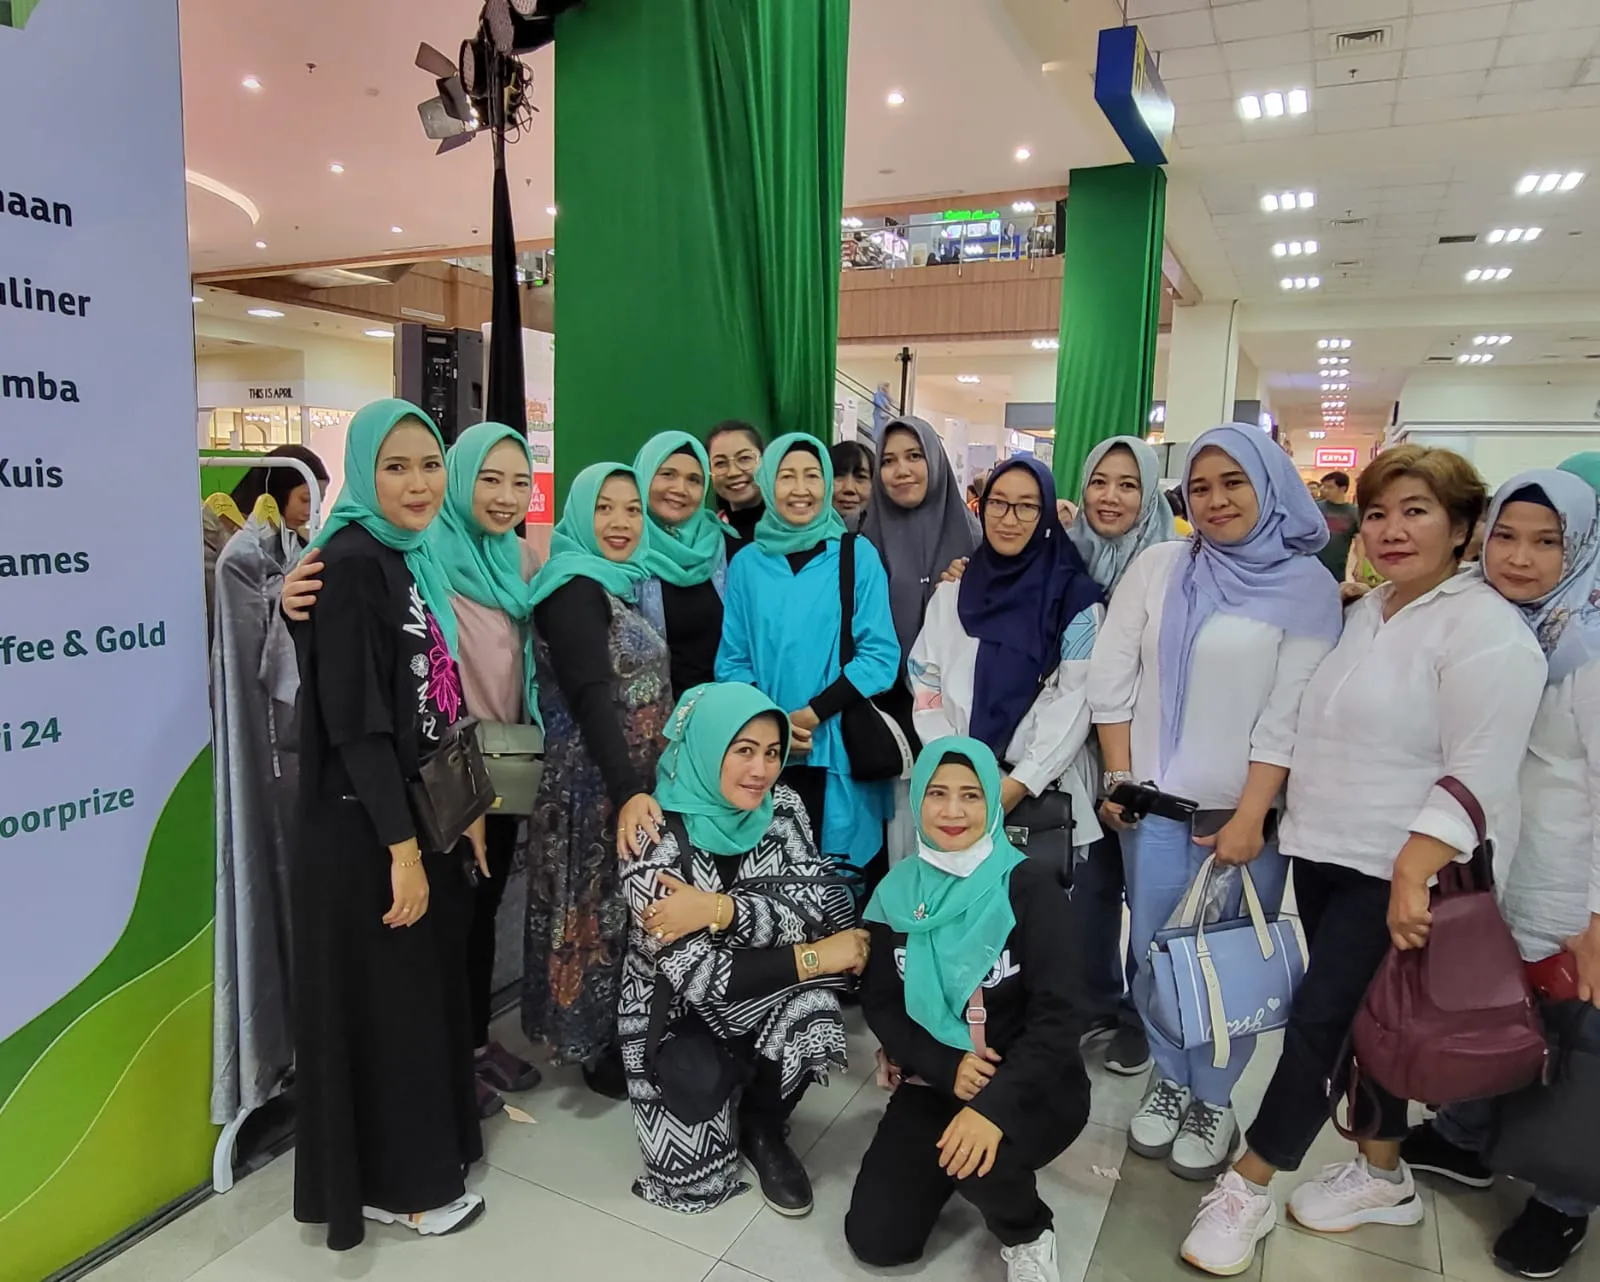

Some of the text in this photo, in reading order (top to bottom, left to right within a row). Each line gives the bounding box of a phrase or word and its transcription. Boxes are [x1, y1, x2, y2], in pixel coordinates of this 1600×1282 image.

[0, 189, 73, 227] aan
[2, 370, 80, 403] mba
[248, 387, 293, 399] THIS IS APRIL
[0, 457, 63, 488] Kuis
[0, 551, 90, 577] ames
[0, 620, 166, 665] fee & Gold
[20, 717, 62, 749] 24
[0, 788, 134, 838] oorprize
